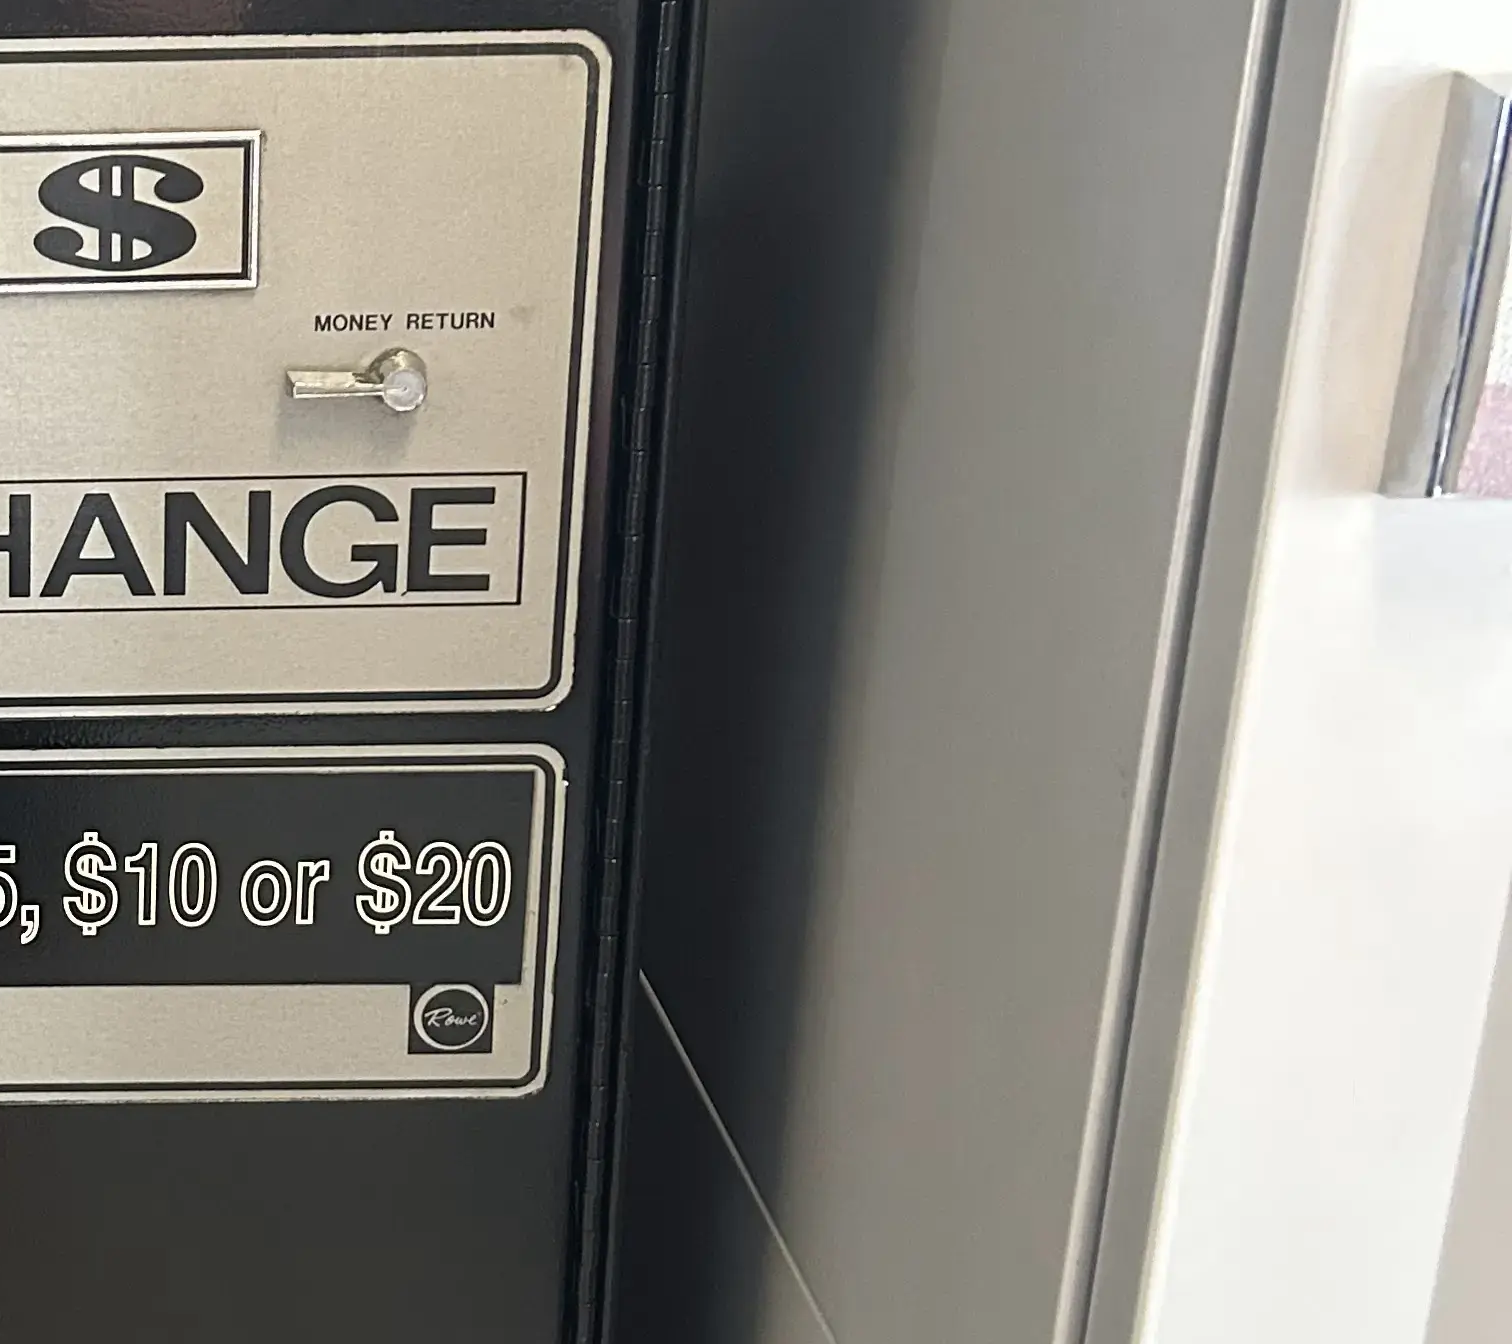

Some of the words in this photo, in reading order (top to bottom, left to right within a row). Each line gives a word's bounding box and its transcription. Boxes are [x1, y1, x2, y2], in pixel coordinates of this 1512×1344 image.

[33, 154, 205, 271] $
[314, 313, 393, 332] MONEY
[406, 311, 496, 331] RETURN
[63, 831, 218, 936] $10
[239, 858, 330, 927] or
[355, 830, 513, 935] $20
[424, 1007, 478, 1027] Rowe
